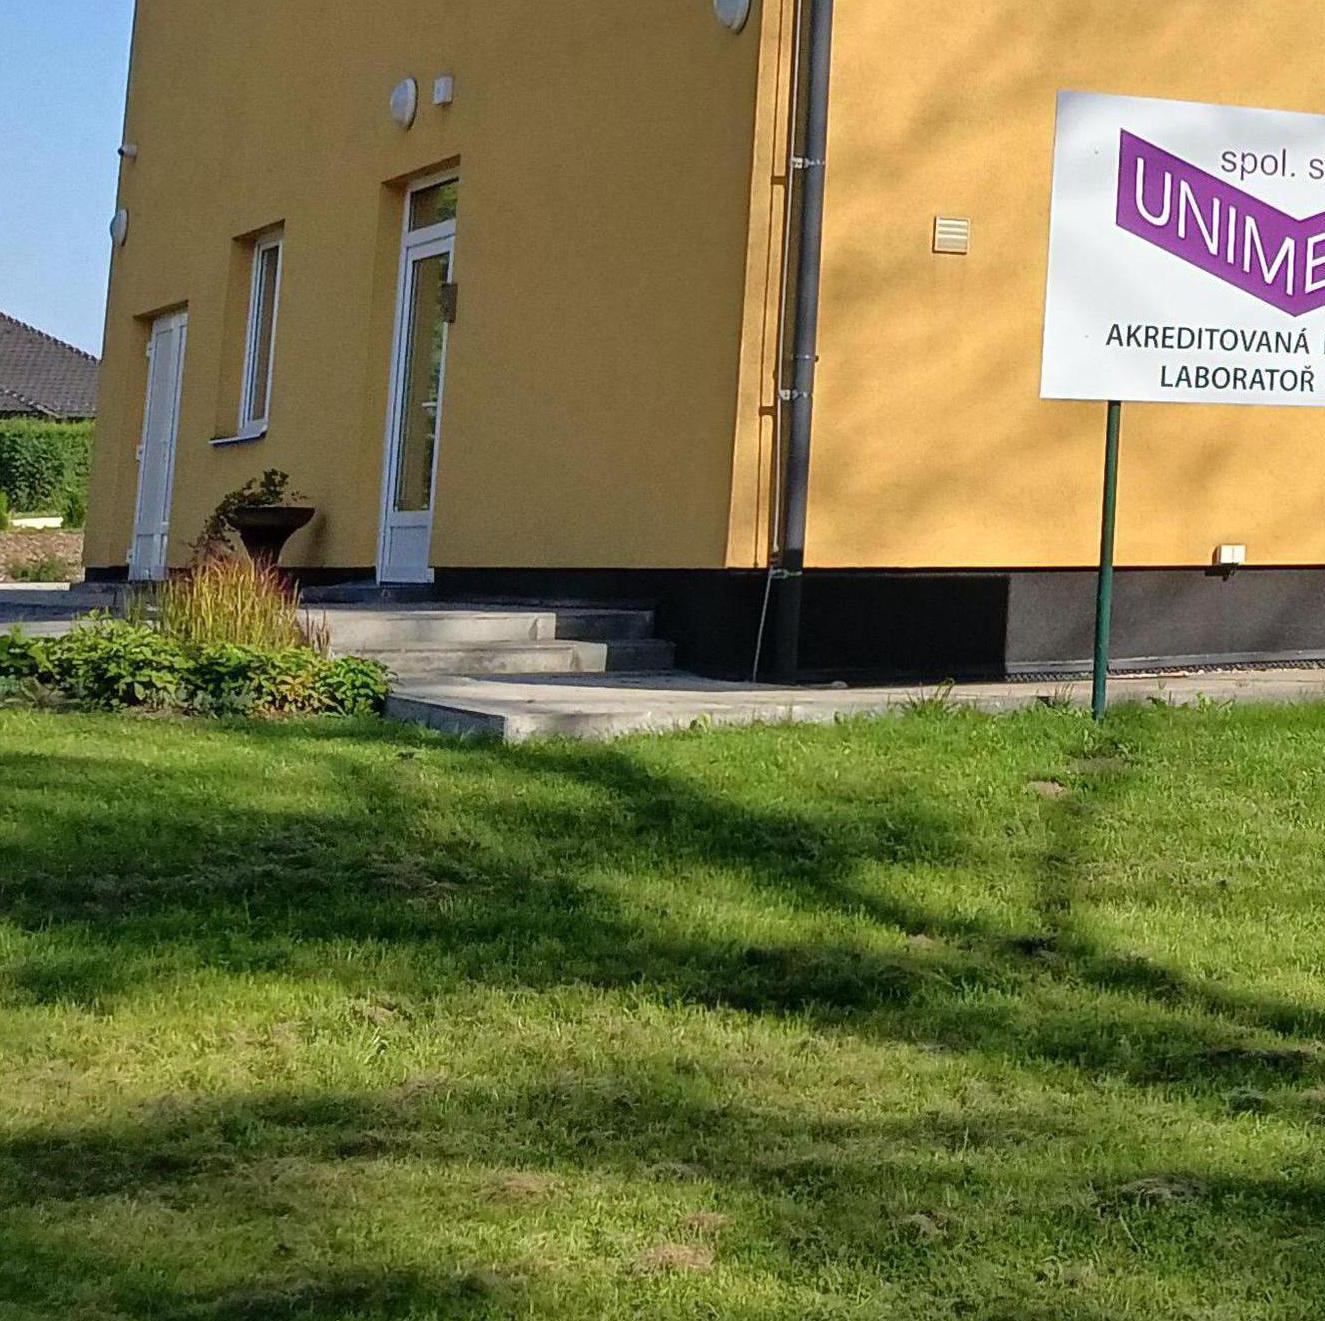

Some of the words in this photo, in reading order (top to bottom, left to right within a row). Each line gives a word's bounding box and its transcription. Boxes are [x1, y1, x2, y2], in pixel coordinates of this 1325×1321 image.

[1219, 148, 1296, 182] spol.
[1308, 158, 1325, 180] s
[1105, 323, 1310, 355] AKREDITOVANÁ
[1160, 363, 1315, 393] LABORATOŘ
